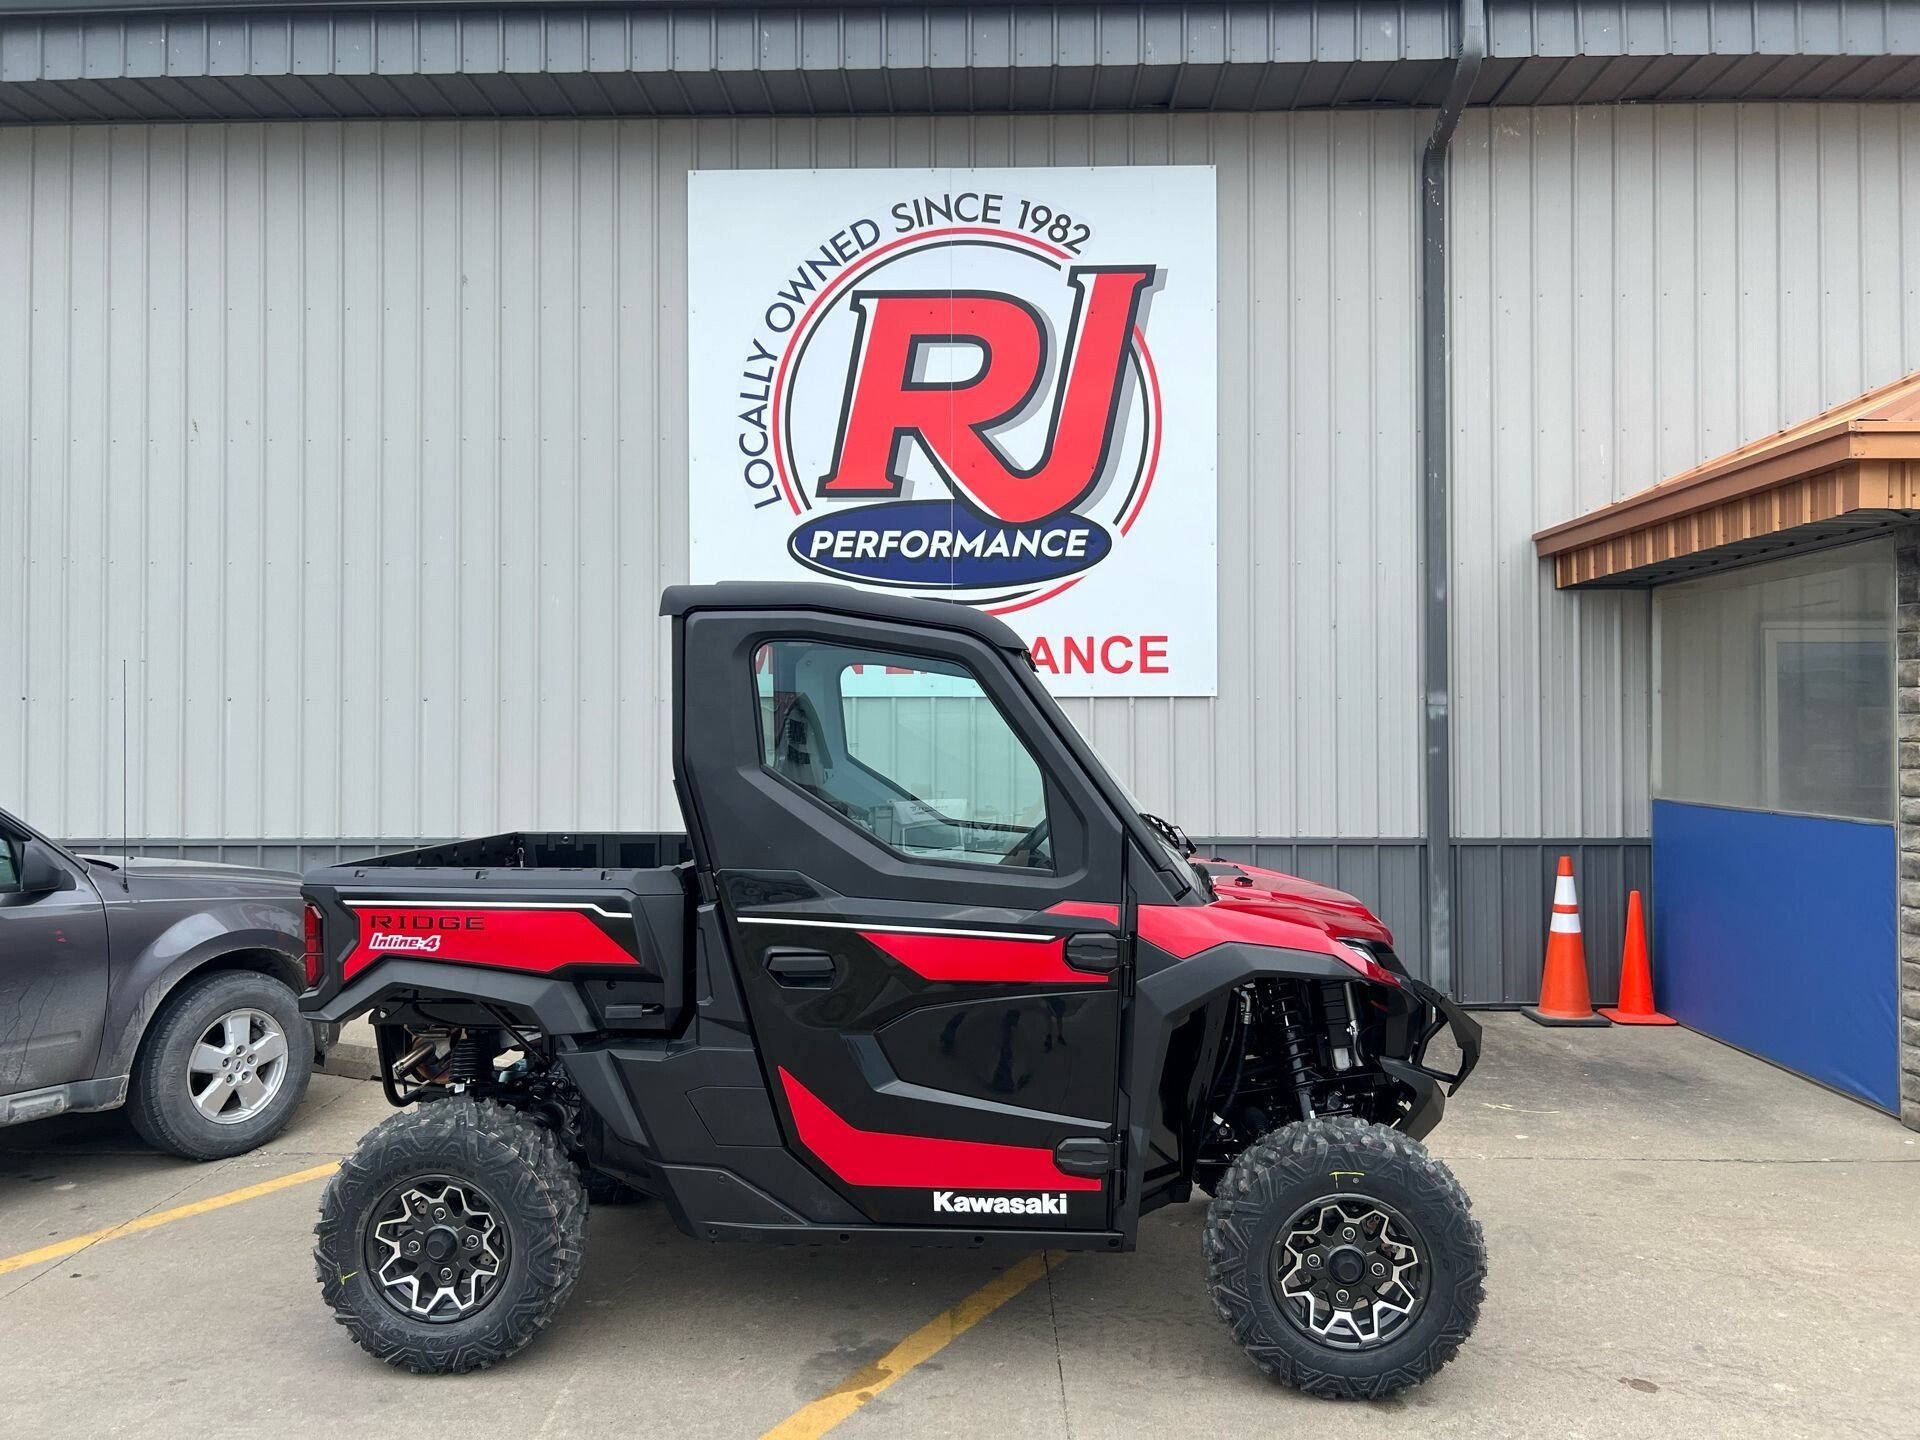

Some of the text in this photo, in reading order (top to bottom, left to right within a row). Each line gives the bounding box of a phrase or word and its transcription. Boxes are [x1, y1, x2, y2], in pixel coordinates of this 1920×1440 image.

[739, 193, 1091, 509] LOCALLY OWNED SINCE 1982
[815, 264, 1160, 526] RJ
[808, 528, 1090, 561] PERFORMANCE
[371, 915, 485, 930] RIDGE
[369, 932, 442, 952] Inline-4
[933, 1191, 1068, 1215] Kawasaki
